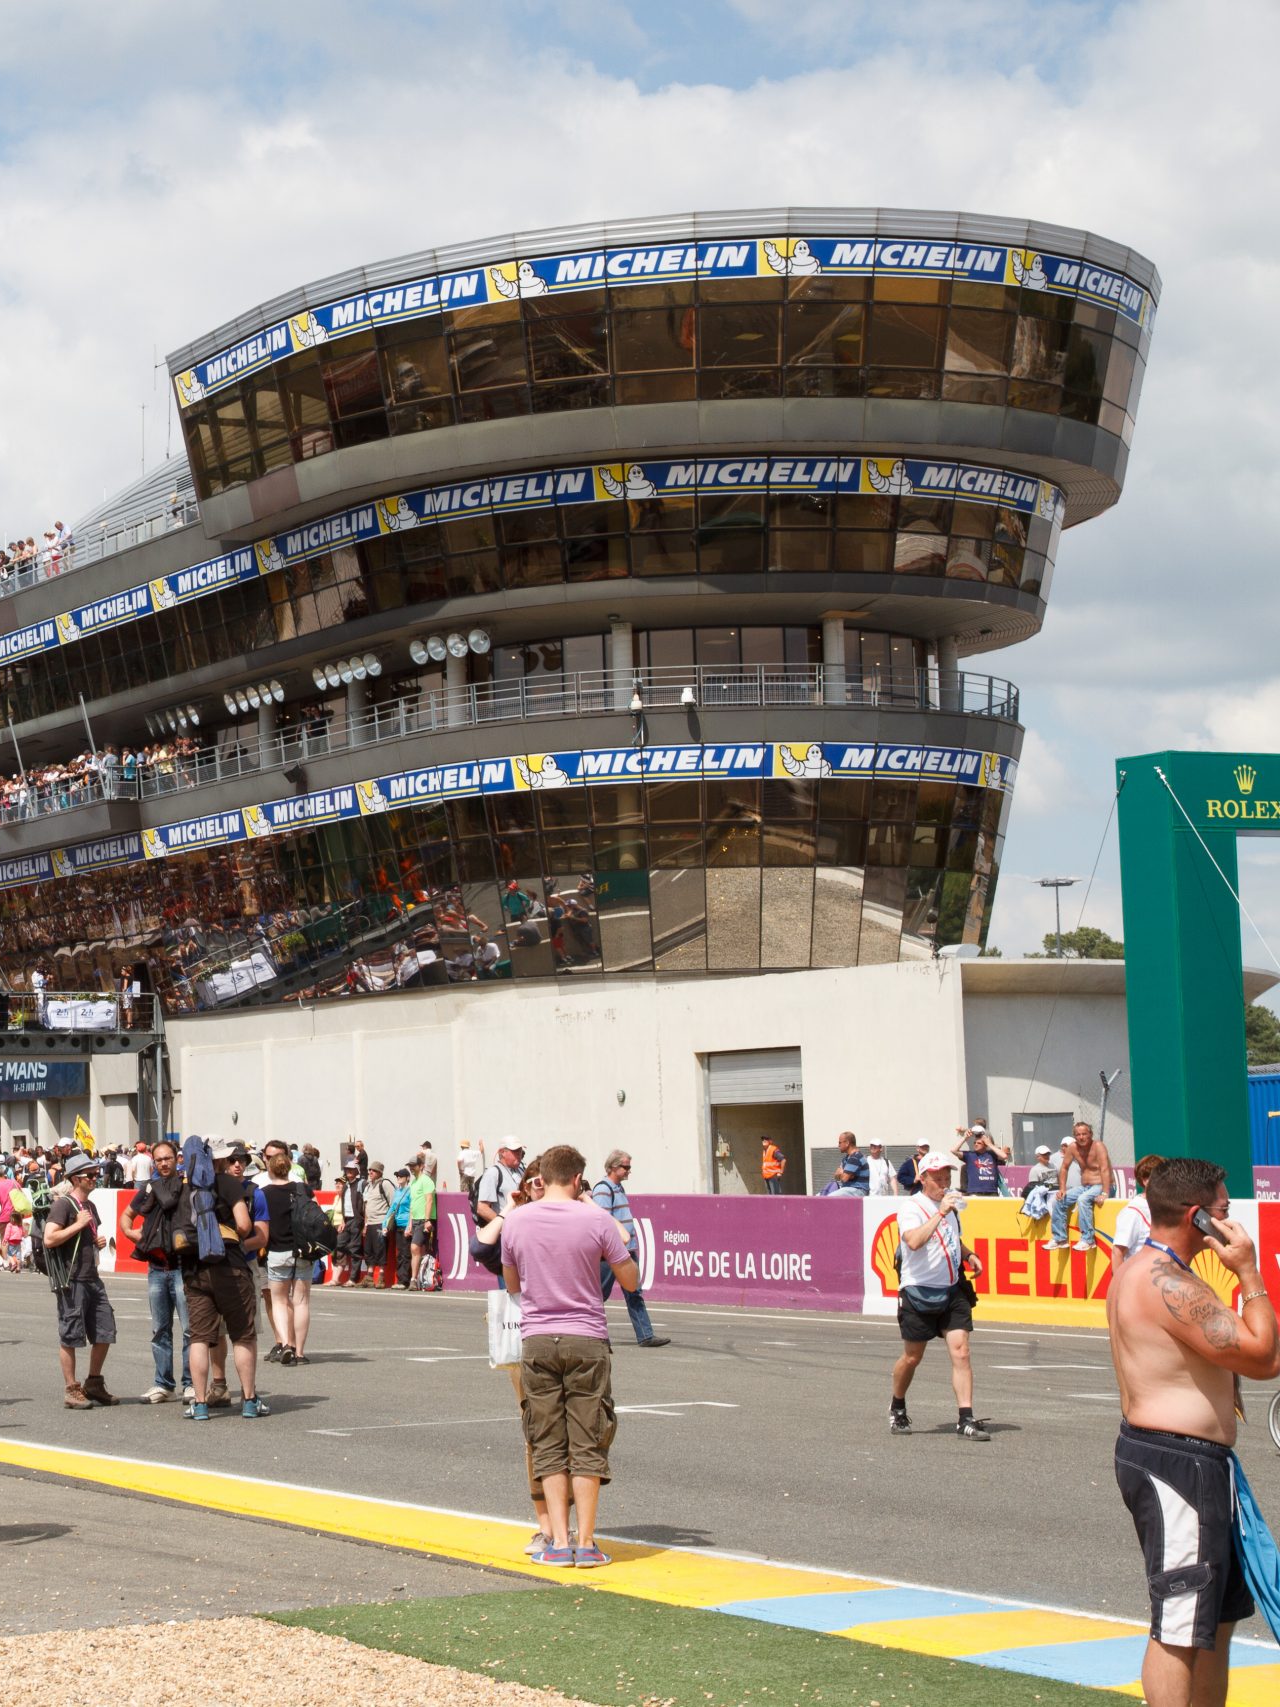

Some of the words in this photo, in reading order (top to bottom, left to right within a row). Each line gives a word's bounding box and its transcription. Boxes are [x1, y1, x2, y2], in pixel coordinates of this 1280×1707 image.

[555, 243, 749, 283] MICHELIN
[830, 243, 1001, 271] MICHELIN
[331, 274, 479, 329] MICHELIN
[1053, 263, 1143, 311] MICHELIN
[206, 326, 287, 385] MICHELIN
[665, 462, 855, 487] MICHELIN
[921, 467, 1038, 503] MICHELIN
[423, 472, 587, 514] MICHELIN
[287, 508, 373, 555] MICHELIN
[178, 551, 252, 593] MICHELIN
[81, 589, 148, 627] MICHELIN
[577, 747, 767, 776] MICHELIN
[840, 748, 979, 774] MICHELIN
[390, 763, 506, 799] MICHELIN
[273, 789, 353, 824] MICHELIN
[168, 814, 239, 846] MICHELIN
[76, 835, 139, 864] MICHELIN
[5, 1061, 48, 1081] MANS
[663, 1230, 689, 1244] Région
[663, 1250, 704, 1277] PAYS
[708, 1252, 730, 1278] DE
[735, 1252, 757, 1279] LA
[761, 1254, 812, 1281] LOIRE
